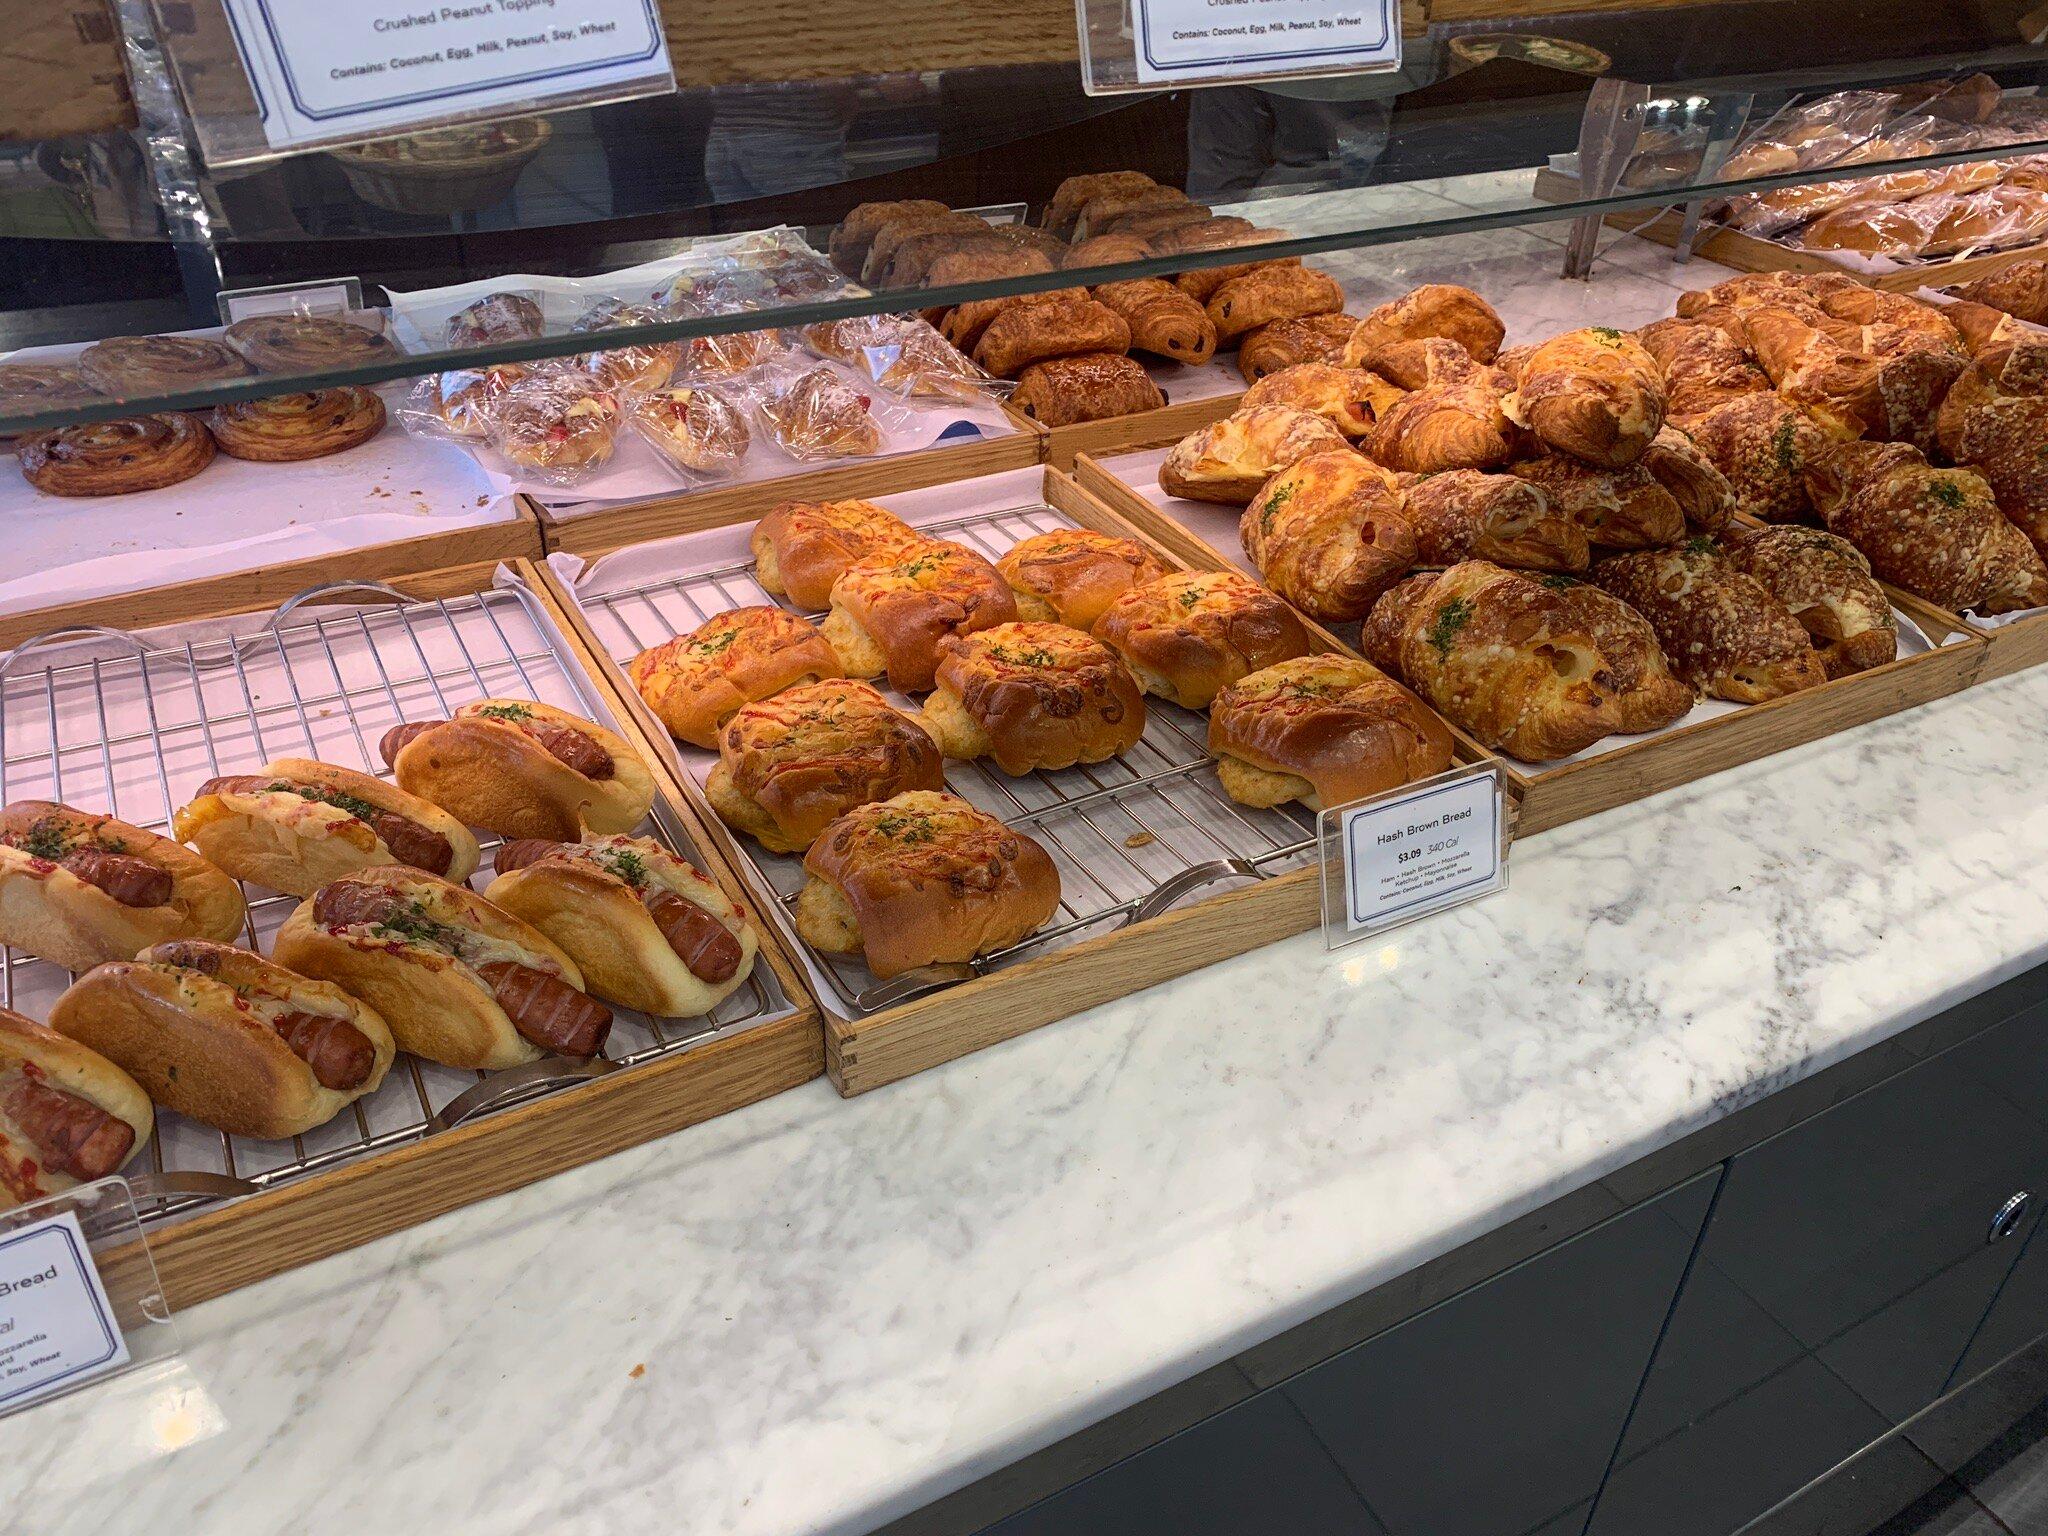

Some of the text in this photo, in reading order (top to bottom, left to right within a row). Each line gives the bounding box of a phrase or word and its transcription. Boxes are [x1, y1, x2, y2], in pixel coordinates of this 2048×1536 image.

[373, 11, 437, 33] Crushed
[441, 3, 494, 21] Peanut
[1172, 17, 1361, 40] Contains: Coconut, Egg, Milk, Peanut, Soy, Wheat
[330, 21, 616, 79] Contains: Coconut, Egg, Milk, Peanut, Soy, Wheat
[1377, 807, 1472, 846] Hash Brown Bread
[1398, 835, 1460, 864] $3.09 340 Cal
